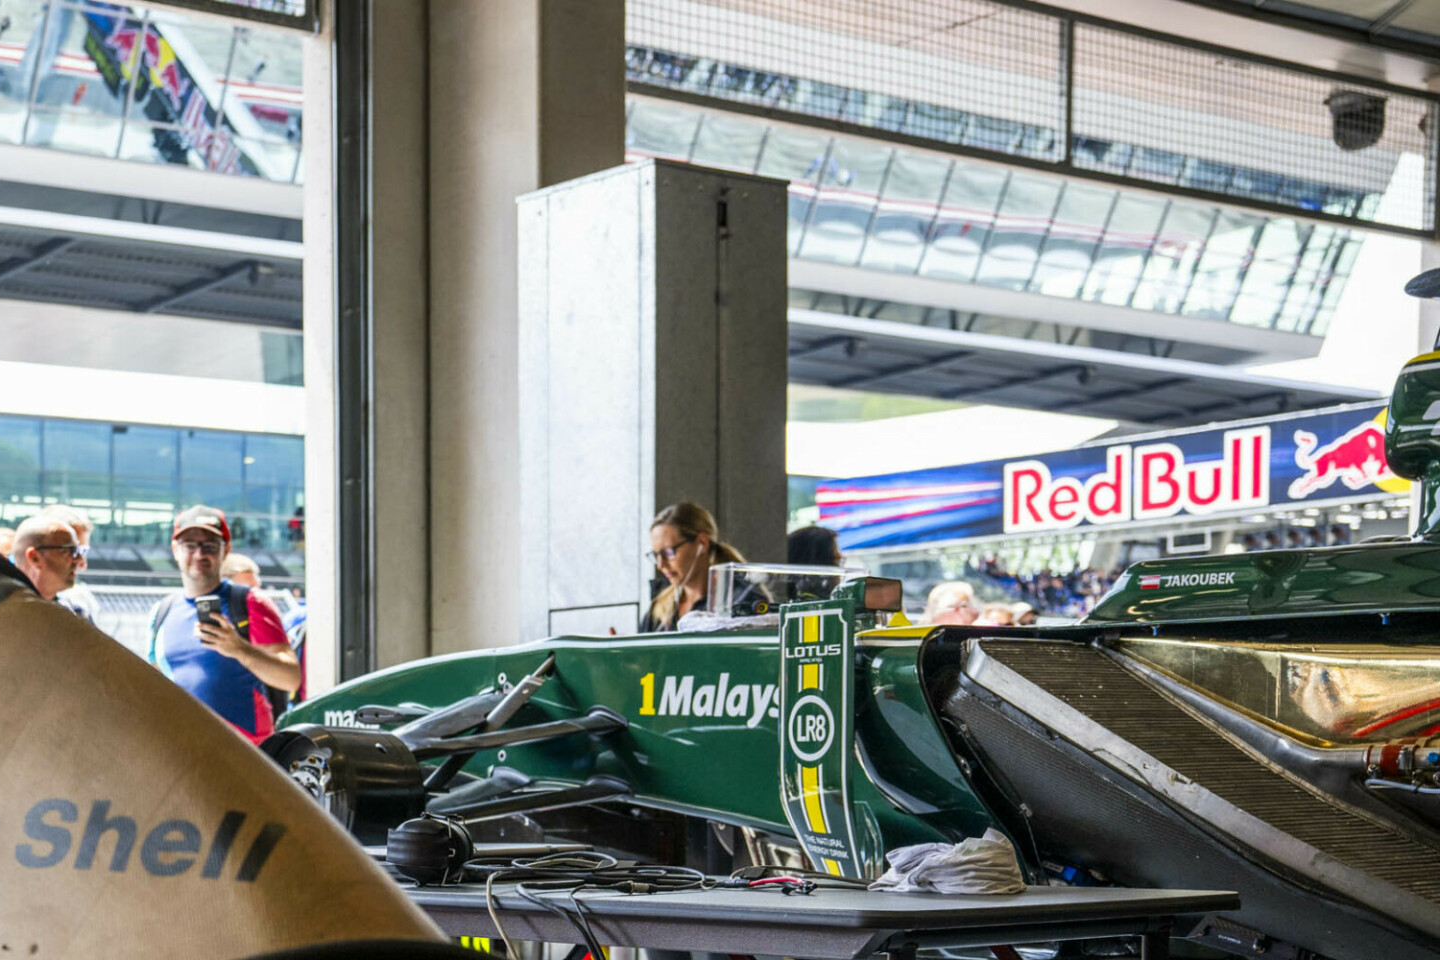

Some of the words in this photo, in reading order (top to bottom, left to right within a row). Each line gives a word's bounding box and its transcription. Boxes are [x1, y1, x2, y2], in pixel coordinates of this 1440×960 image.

[1010, 453, 1123, 527] Red
[1139, 434, 1263, 512] Bull
[1164, 572, 1236, 588] JAKOUBEK
[785, 643, 841, 658] LOTUS
[797, 714, 827, 742] LR8
[14, 798, 288, 883] Shell
